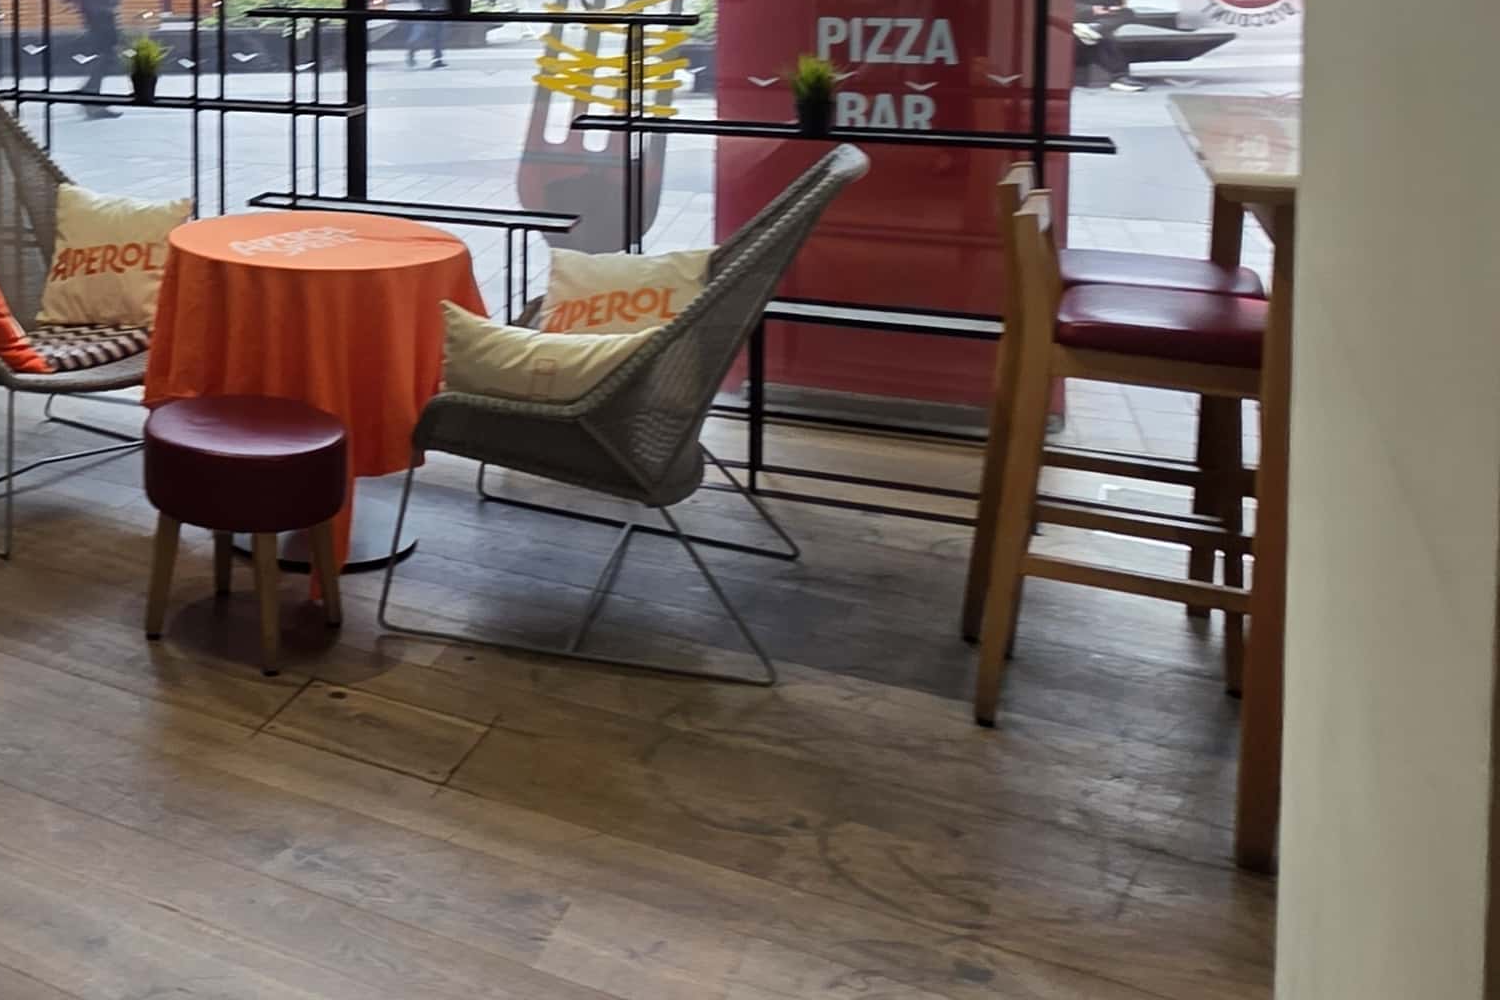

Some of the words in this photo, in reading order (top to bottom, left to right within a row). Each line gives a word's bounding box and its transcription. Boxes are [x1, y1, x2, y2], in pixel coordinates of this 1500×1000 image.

[816, 16, 959, 66] PIZZA
[834, 91, 936, 131] BAR
[50, 241, 165, 282] APEROL
[544, 286, 677, 333] APEROL
